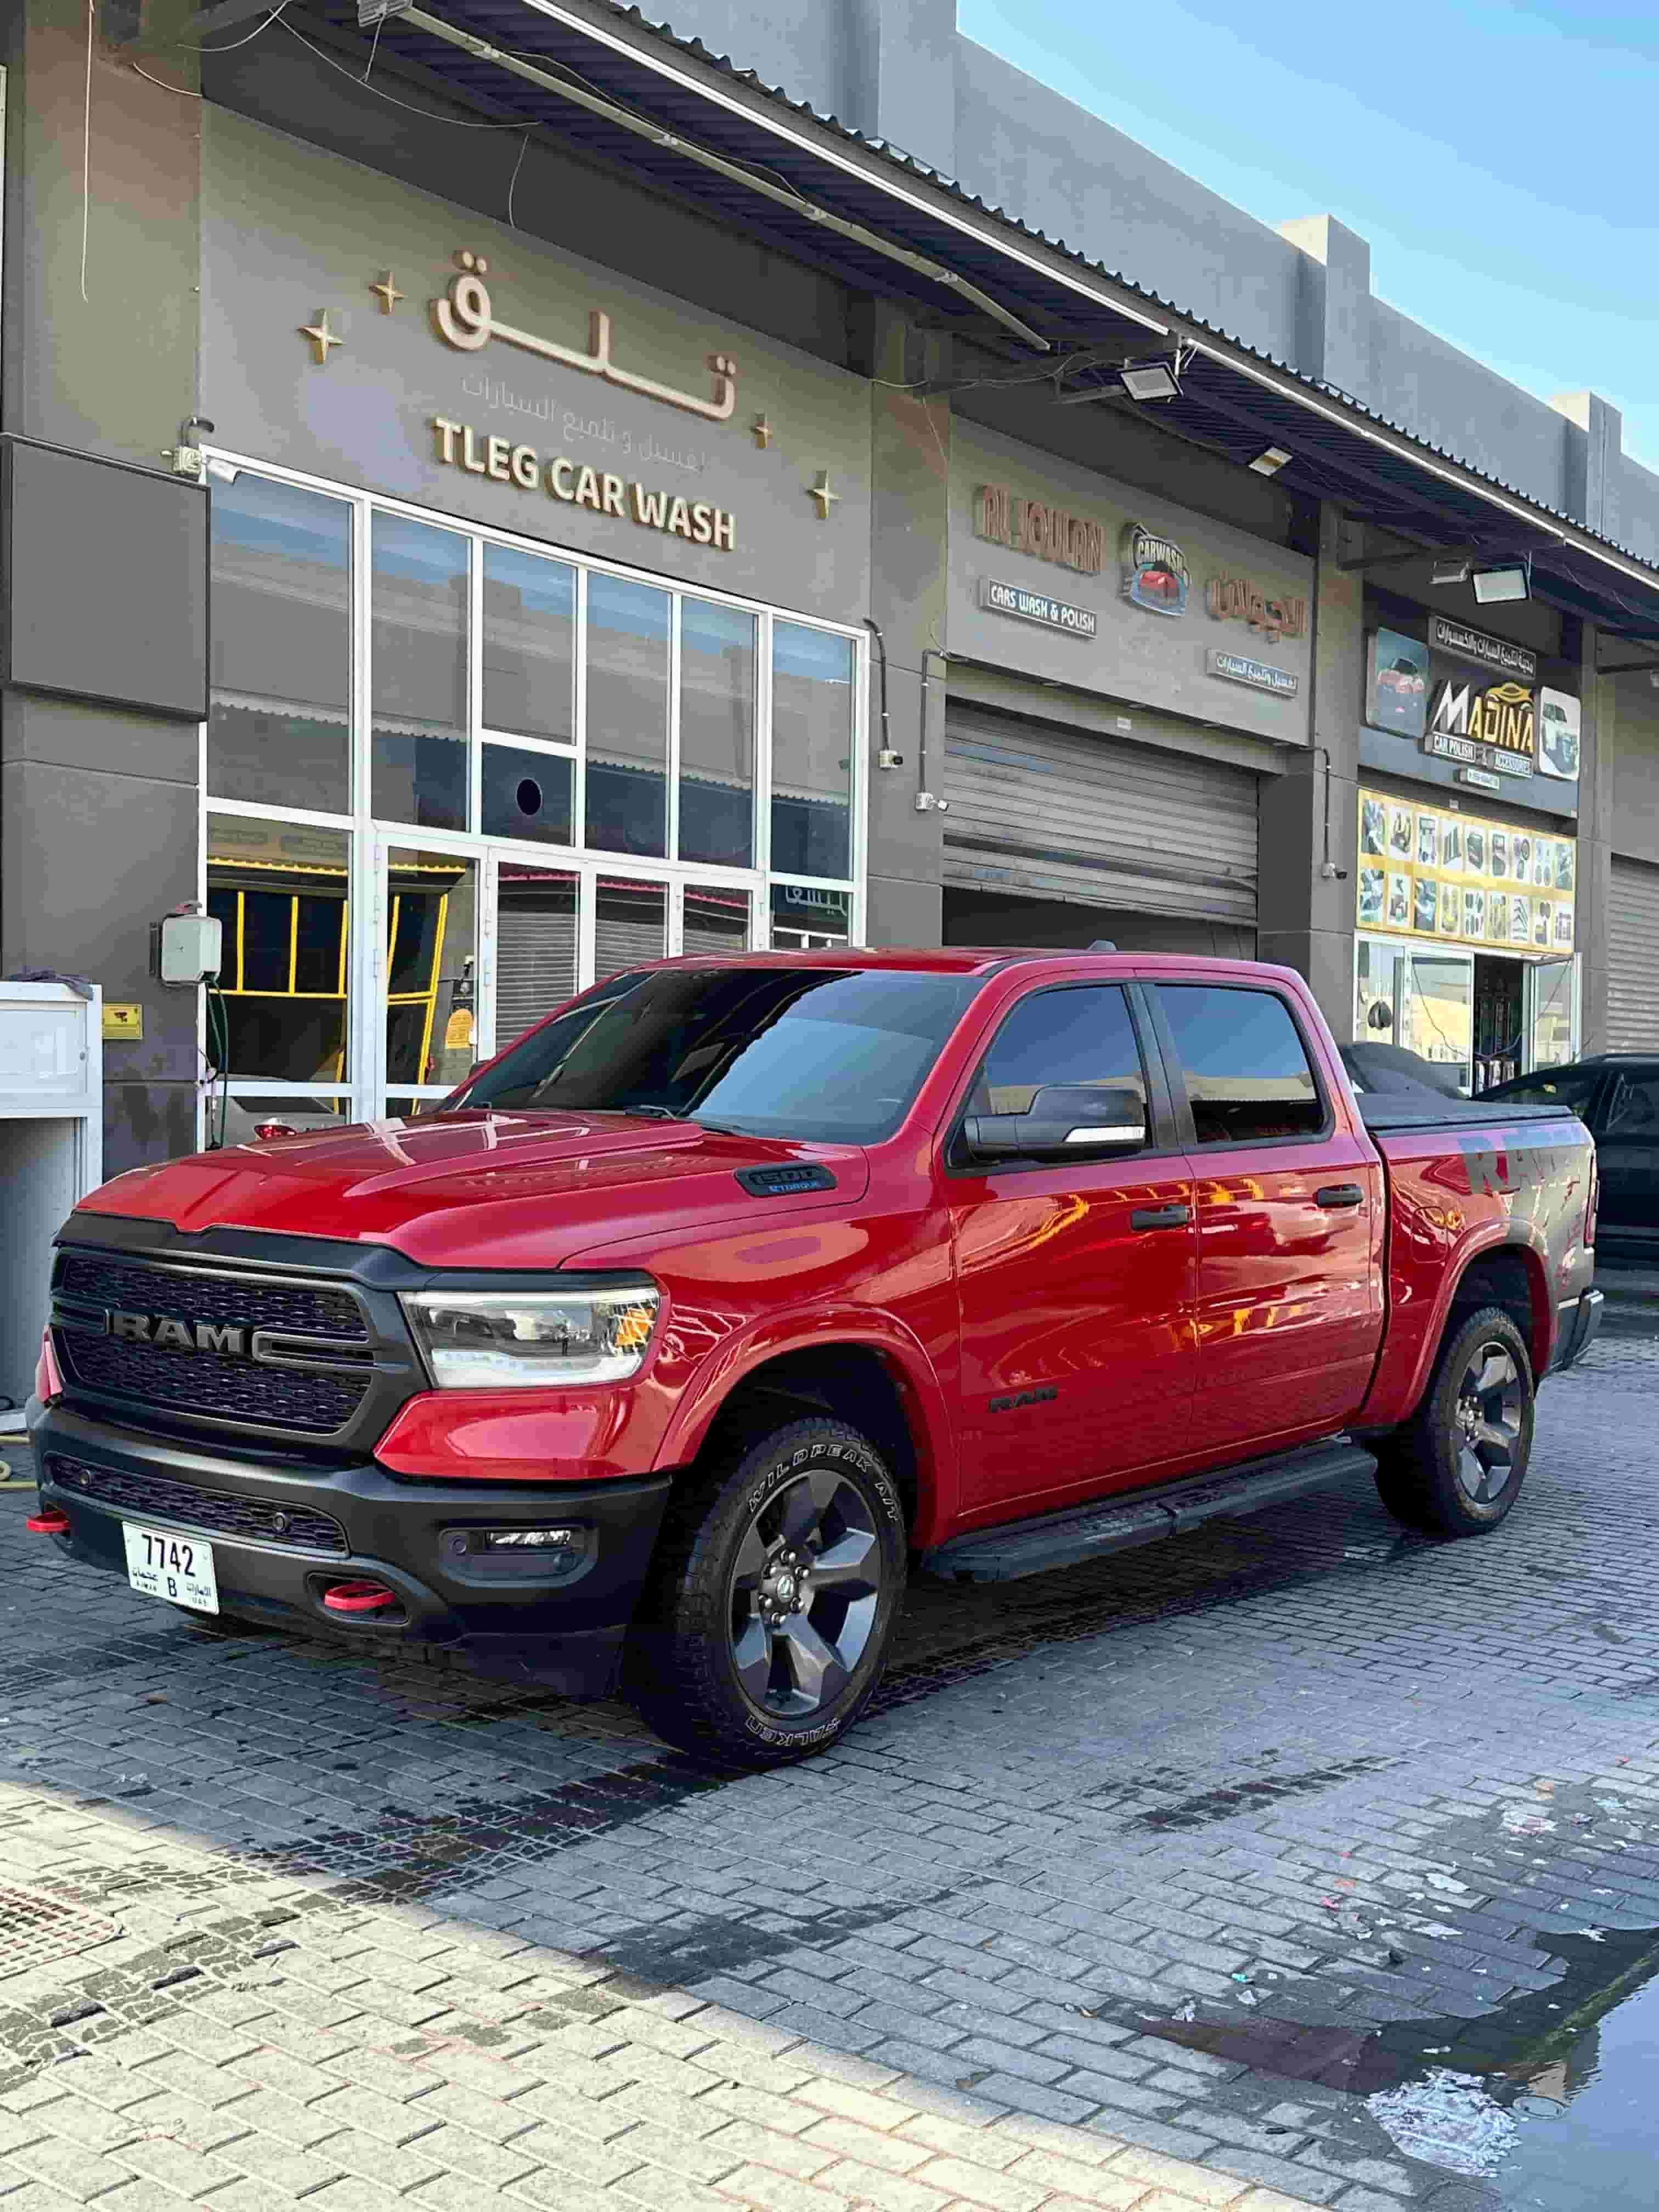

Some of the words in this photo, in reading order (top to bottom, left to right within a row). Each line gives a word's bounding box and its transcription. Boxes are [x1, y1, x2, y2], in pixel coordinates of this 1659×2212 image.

[461, 373, 556, 421] السيارات
[435, 417, 540, 489] TLEG
[549, 456, 627, 520] CAR
[630, 481, 736, 552] WASH
[991, 584, 1017, 608] CARS
[1018, 591, 1048, 619] WASH
[1050, 603, 1059, 622] &
[1061, 605, 1094, 633] POLISH
[1431, 680, 1535, 752] MADINA
[1435, 735, 1449, 754] CAR
[1449, 740, 1474, 761] POLISH
[113, 1310, 245, 1353] RAM
[748, 1443, 872, 1514] WILDPEAK
[142, 1534, 196, 1577] 7742
[167, 1576, 177, 1598] B
